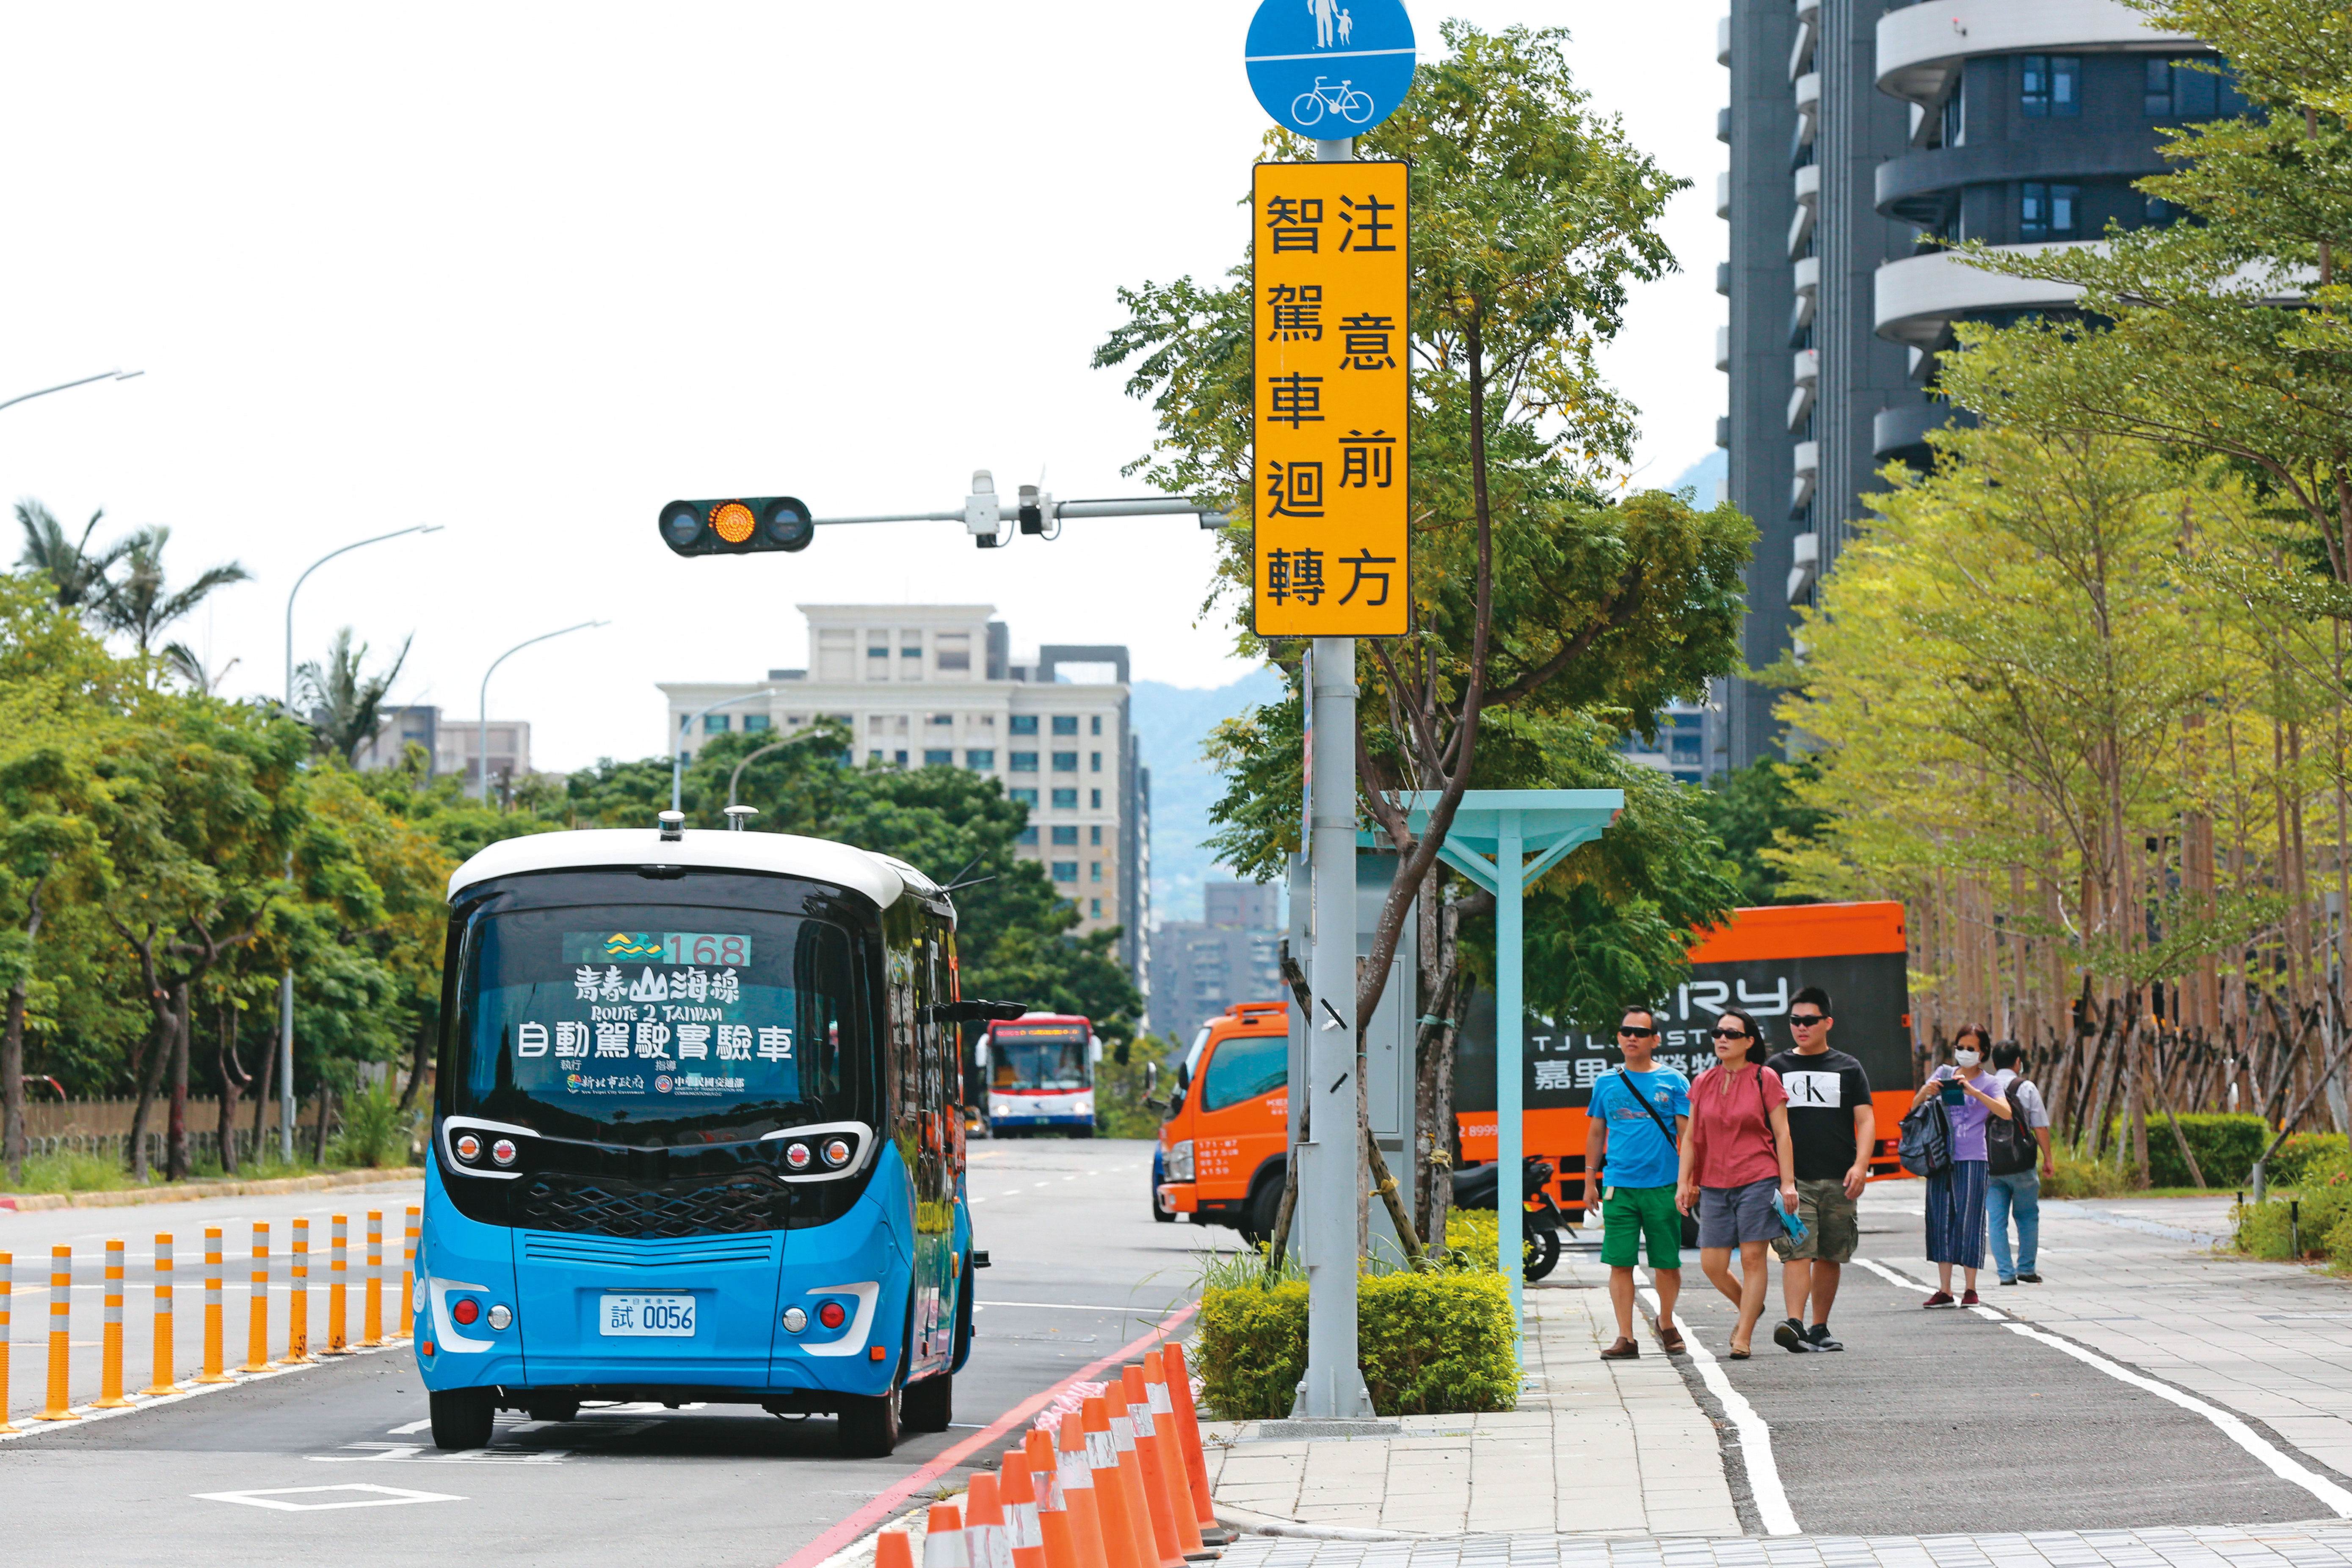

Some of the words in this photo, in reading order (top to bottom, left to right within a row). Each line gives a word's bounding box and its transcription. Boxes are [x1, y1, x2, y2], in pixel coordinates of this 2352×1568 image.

[1266, 194, 1326, 607] 智駕車迴轉
[1337, 194, 1397, 607] 注意前方
[670, 935, 744, 966] 168
[574, 964, 740, 1004] 青春山海線
[591, 1005, 638, 1022] ROUTE
[643, 1003, 657, 1023] 2
[662, 1005, 723, 1023] TAIWAN
[517, 1021, 792, 1063] 自動駕駛實驗車
[560, 1059, 582, 1071] 執行
[654, 1060, 677, 1071] 指導
[581, 1074, 645, 1090] 新北市政府
[674, 1076, 745, 1088] 中華民國交通部
[611, 1305, 634, 1328] 試
[643, 1306, 693, 1329] 0056
